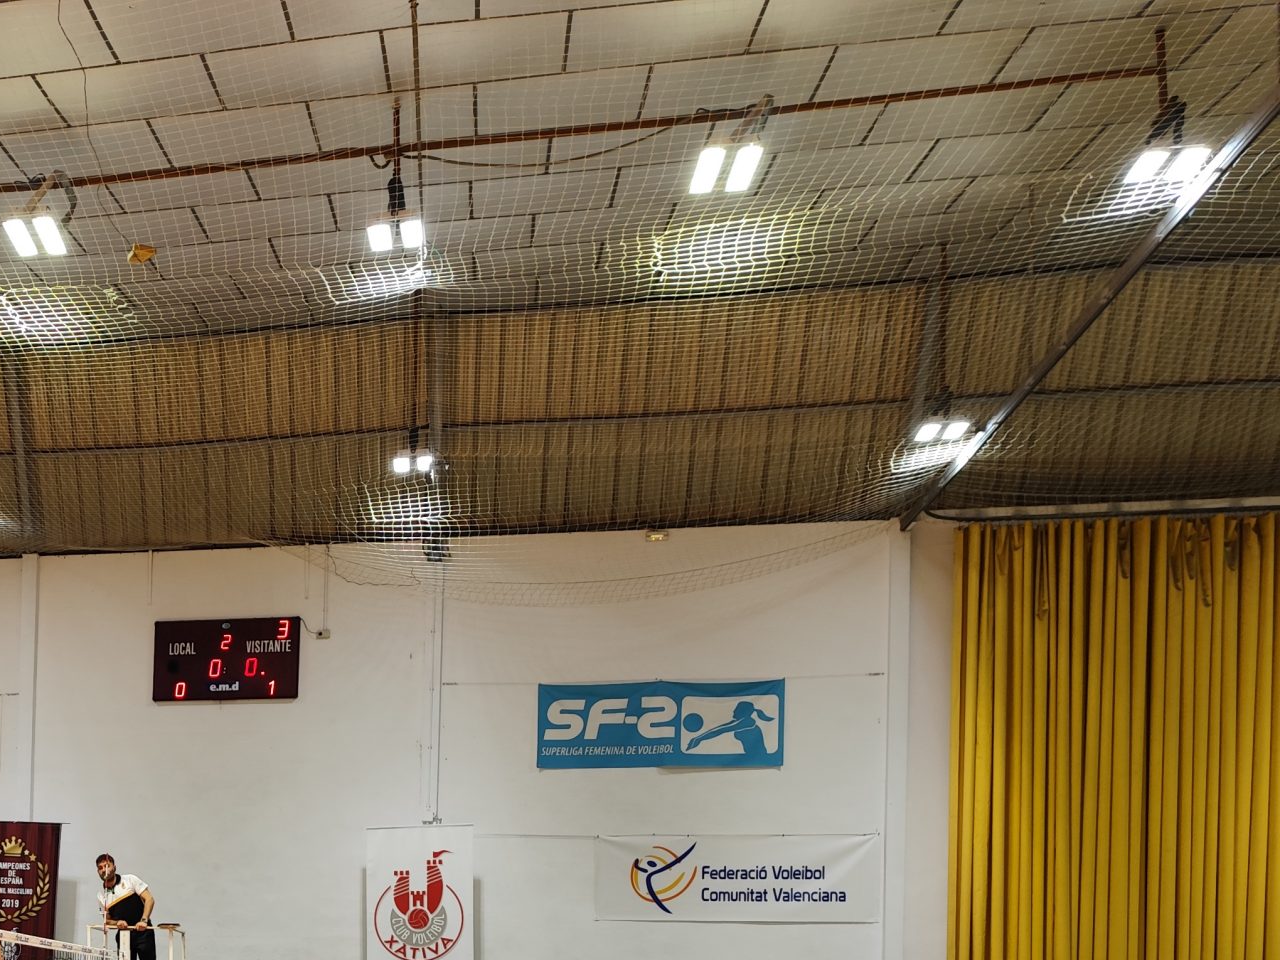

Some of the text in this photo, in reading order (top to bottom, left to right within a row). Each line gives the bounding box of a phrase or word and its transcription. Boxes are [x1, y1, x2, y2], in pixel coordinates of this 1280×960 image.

[277, 620, 289, 638] 3
[169, 640, 291, 655] LOCAL VISITANTE
[221, 634, 232, 650] 2
[175, 682, 186, 697] 0
[268, 680, 275, 696] 1
[543, 696, 677, 740] SF-2
[541, 744, 674, 756] SUPERLIGA FEMENINA DE VOLEIBOL
[7, 869, 17, 877] DE
[701, 865, 825, 880] Federació Voleibol
[0, 876, 23, 885] ESPAÑA
[7, 887, 33, 895] MASCULINO
[701, 887, 846, 902] Comunitat Valenciana
[1, 898, 20, 908] 2019
[392, 913, 445, 945] CLUB VOLEIBOL
